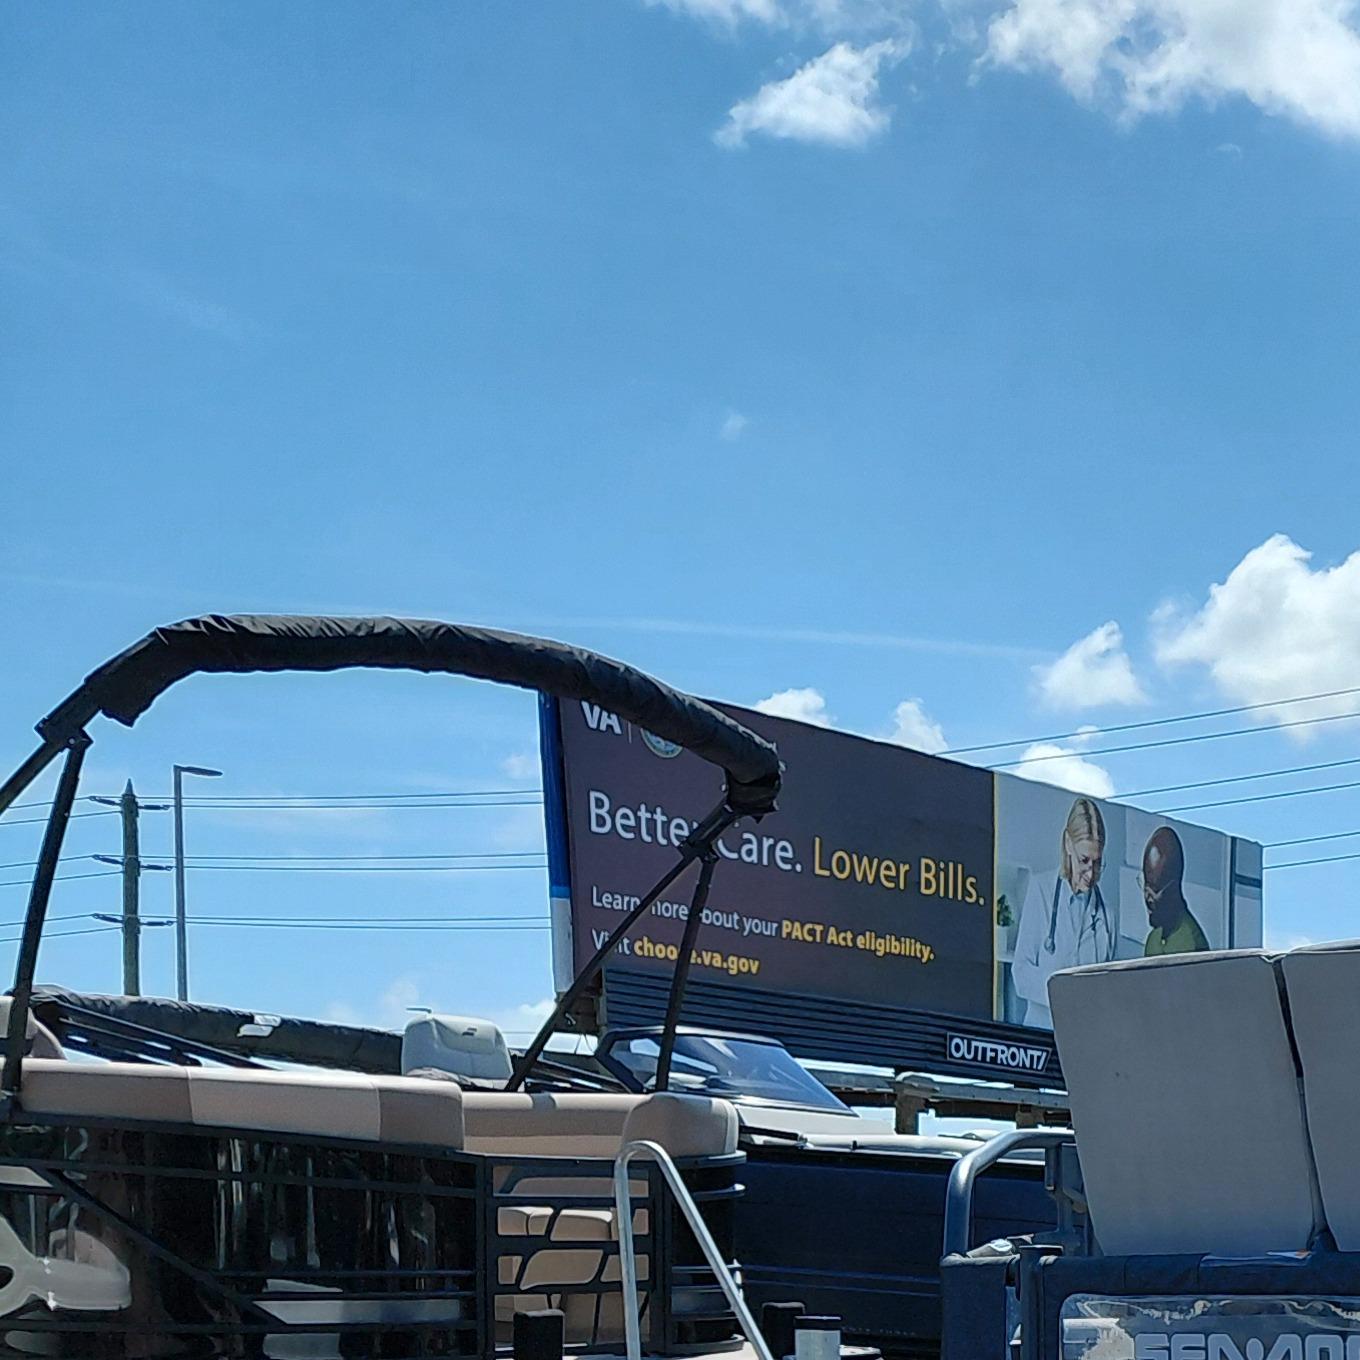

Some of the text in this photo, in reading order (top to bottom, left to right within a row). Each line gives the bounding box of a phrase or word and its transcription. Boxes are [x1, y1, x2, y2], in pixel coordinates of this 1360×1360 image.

[588, 790, 700, 847] Bette
[814, 836, 909, 890] Lower
[919, 857, 985, 906] Bills.
[592, 929, 760, 975] Viit chooe.va.gov
[699, 907, 740, 930] bout
[742, 916, 779, 937] your
[781, 919, 824, 944] PACT
[827, 929, 854, 948] Act
[856, 932, 935, 963] eligibility.
